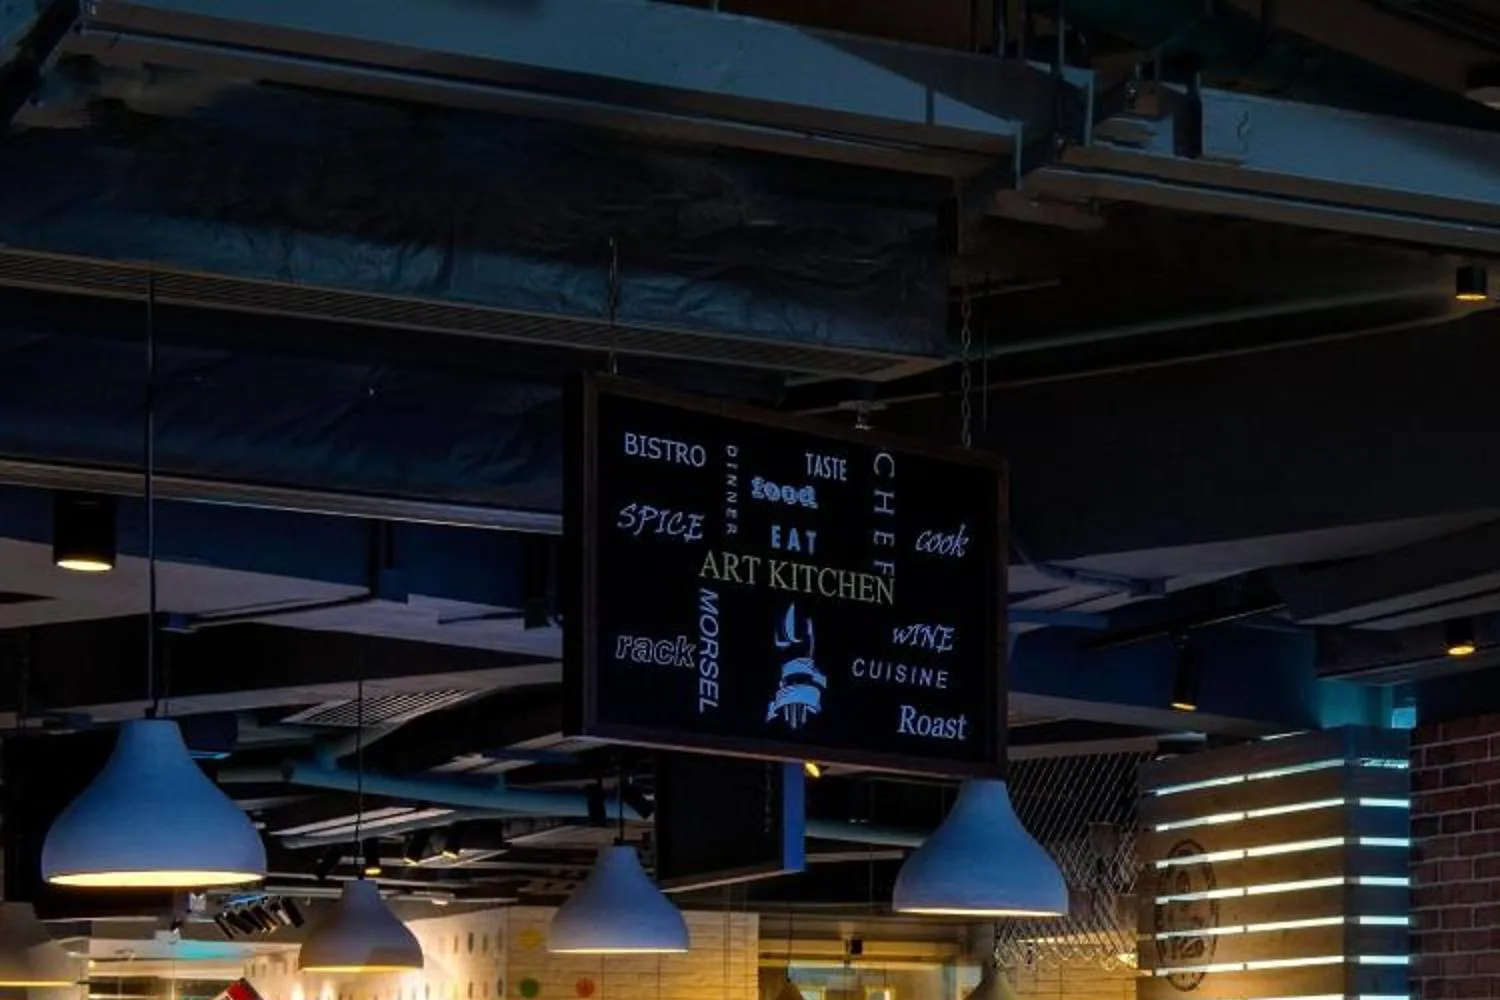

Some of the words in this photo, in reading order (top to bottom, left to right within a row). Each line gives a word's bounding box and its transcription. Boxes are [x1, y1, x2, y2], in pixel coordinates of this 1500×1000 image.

[624, 432, 707, 467] BISTRO
[805, 452, 848, 482] TASTE
[726, 445, 739, 536] DINNER
[617, 502, 704, 543] SPICE
[873, 453, 896, 577] CHEF
[771, 525, 818, 556] EAT
[915, 523, 970, 558] cook
[699, 549, 761, 586] ART
[768, 559, 896, 605] KITCHEN
[615, 635, 697, 668] rack
[699, 587, 720, 713] MORSEL
[851, 657, 950, 690] CUISINE
[897, 705, 969, 741] Roast
